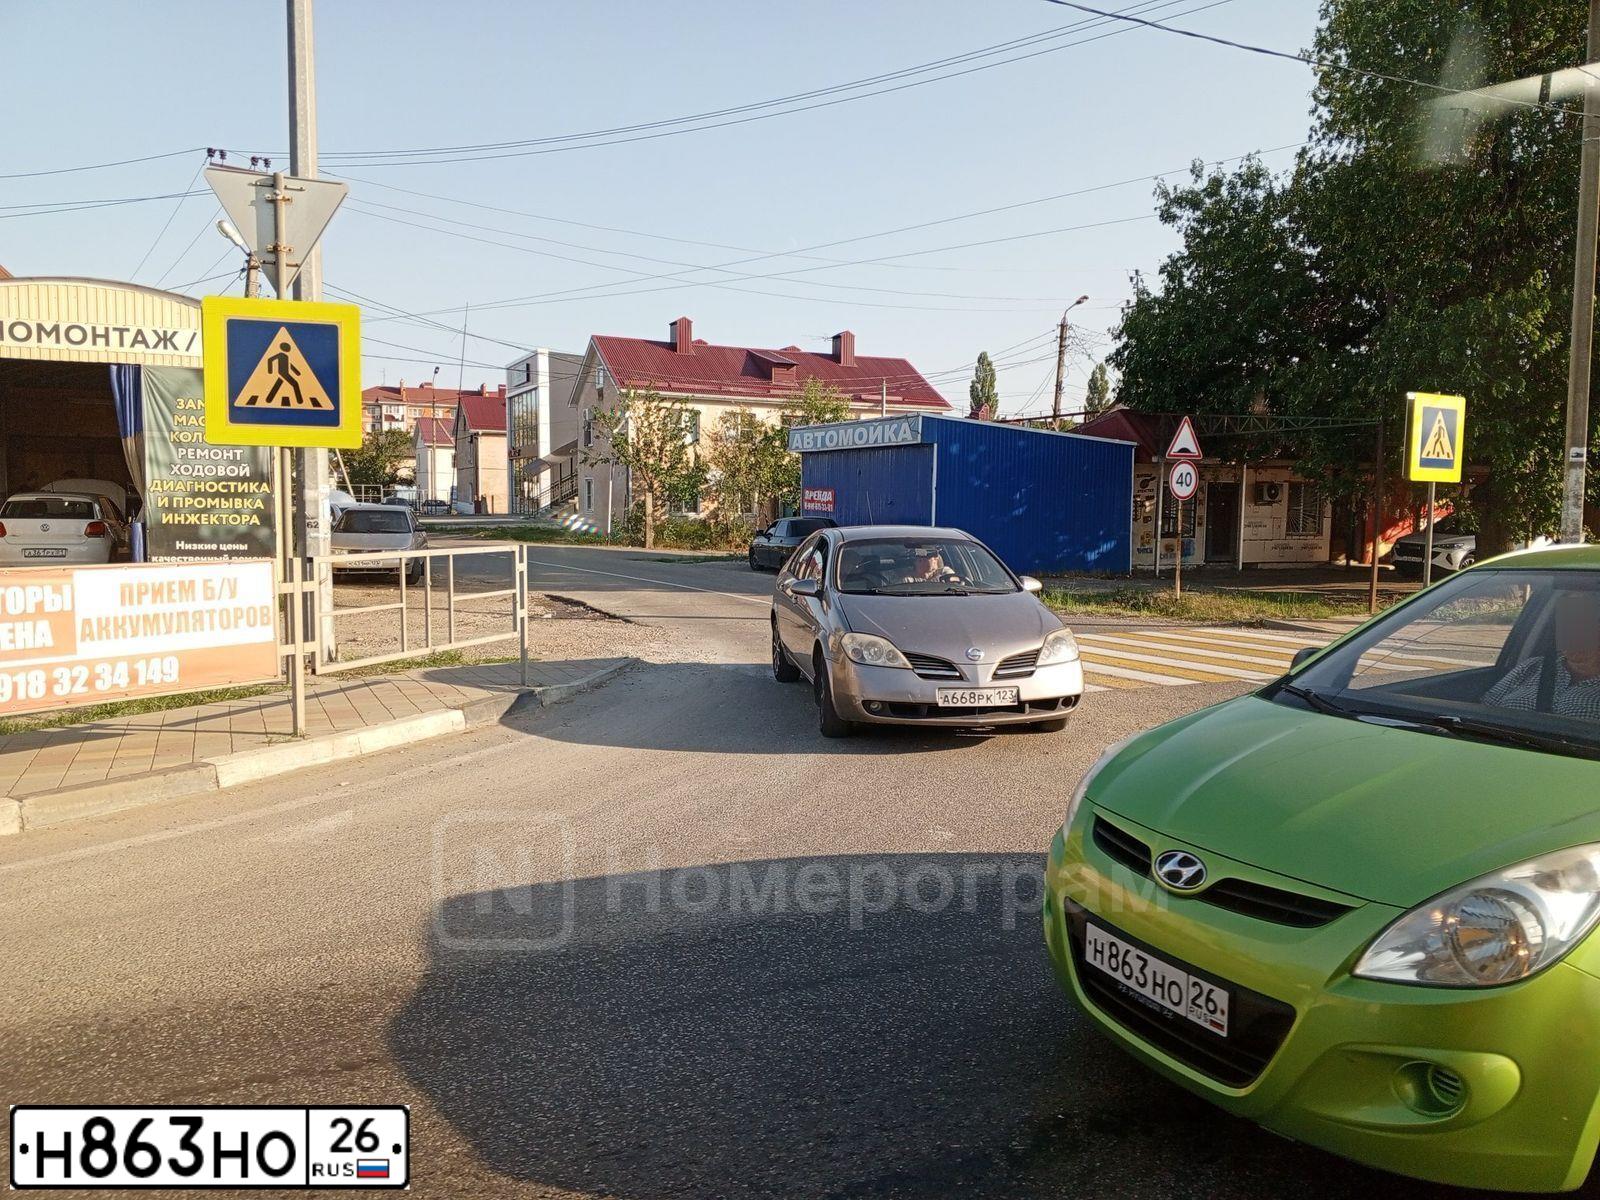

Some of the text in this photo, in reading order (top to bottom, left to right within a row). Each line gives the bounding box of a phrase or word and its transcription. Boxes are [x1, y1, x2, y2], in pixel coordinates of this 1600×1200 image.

[0, 320, 179, 351] ОМОНТАЖ
[170, 431, 206, 443] КОЛ
[791, 421, 913, 449] АВТОМОЙКА
[177, 447, 244, 461] РЕМОНТ
[169, 463, 251, 478] ХОДОВОЙ
[150, 479, 271, 494] ДИАГНОСТИКА
[1176, 472, 1192, 487] 40
[157, 496, 265, 510] И ПРОМЫВКА
[161, 512, 261, 526] ИНЖЕКТОРА
[306, 521, 320, 529] 62
[175, 540, 248, 552] Низкие цены
[119, 578, 197, 607] ПРИЕМ
[202, 577, 238, 600] Б/У
[80, 605, 273, 643] АККУМУЛЯТОРОВ
[52, 664, 90, 696] 32
[94, 660, 130, 691] 34
[134, 655, 180, 686] 149
[942, 690, 1014, 705] А668РК 123
[1093, 937, 1183, 1008] Н863НО
[1191, 981, 1218, 1015] 26
